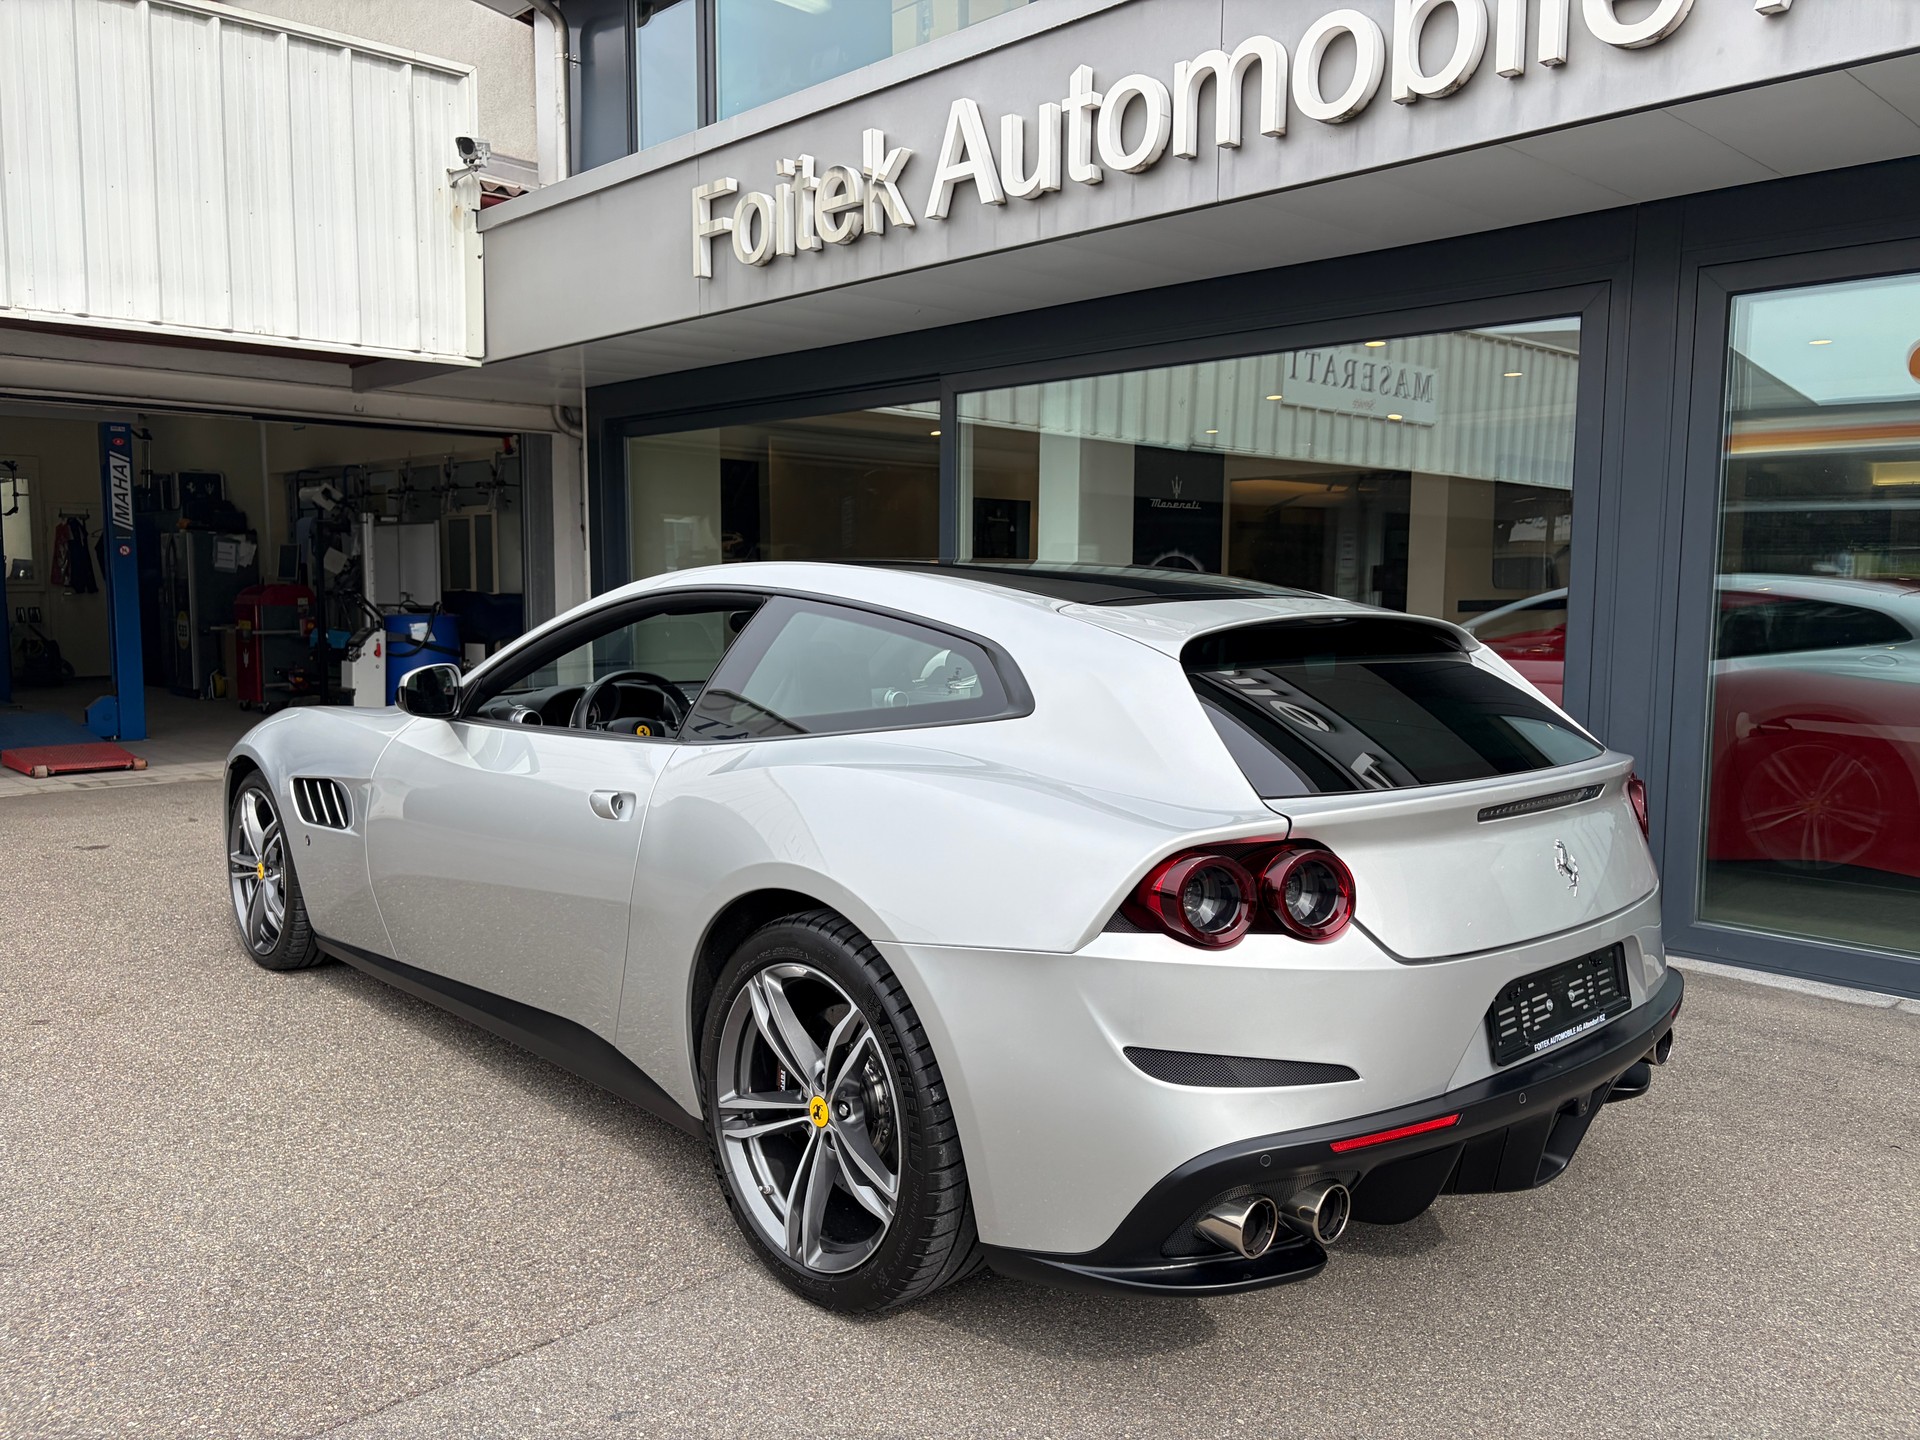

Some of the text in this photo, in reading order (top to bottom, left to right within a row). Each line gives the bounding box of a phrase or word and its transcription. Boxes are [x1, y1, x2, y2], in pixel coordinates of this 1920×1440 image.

[691, 127, 914, 280] Foitek
[112, 463, 130, 522] MAHA
[1150, 498, 1202, 510] Maserati
[1534, 1038, 1551, 1051] FOITEK
[1550, 1027, 1576, 1045] AUTOMOBILE
[880, 1022, 922, 1161] MICHELIN
